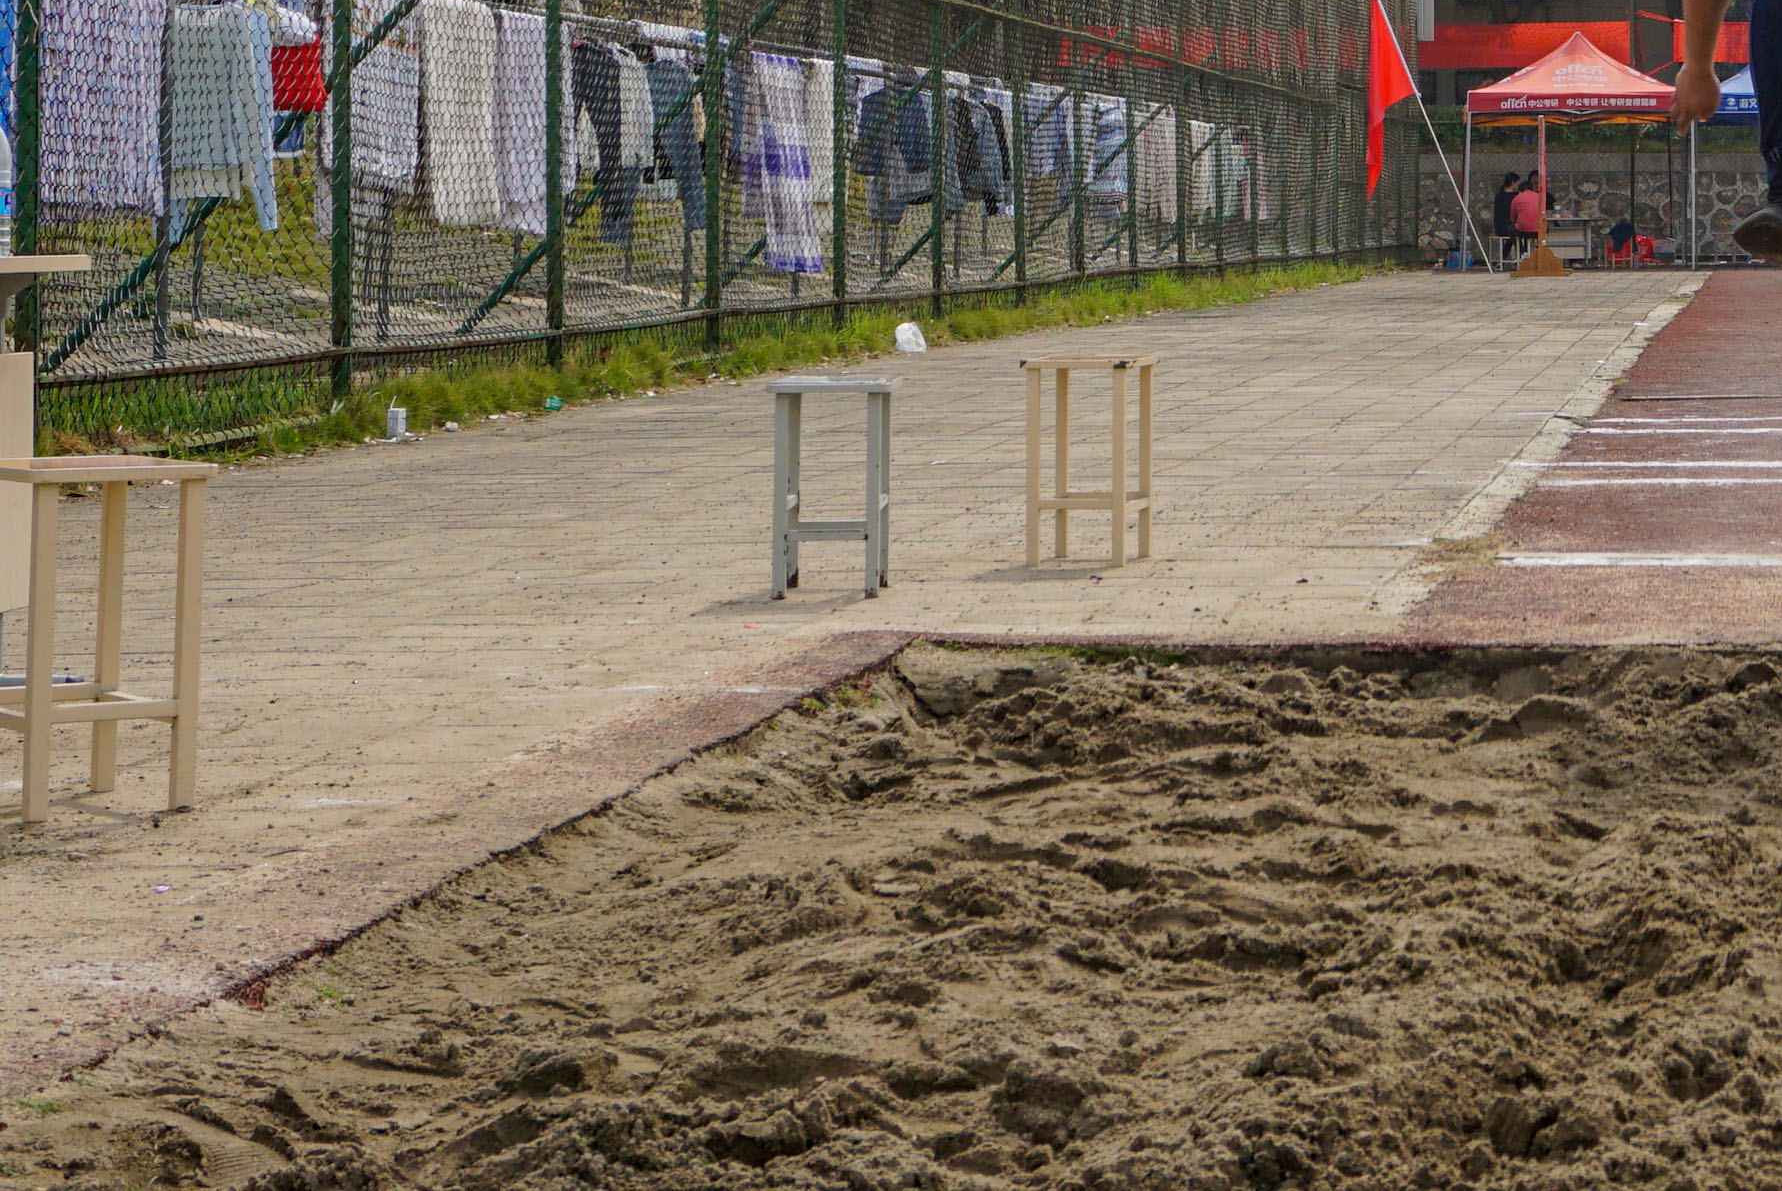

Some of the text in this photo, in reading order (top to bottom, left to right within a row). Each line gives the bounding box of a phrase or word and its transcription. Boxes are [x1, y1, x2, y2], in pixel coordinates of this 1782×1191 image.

[1500, 95, 1528, 109] offcn
[1528, 98, 1559, 108] 中公考研
[1566, 98, 1599, 107] 中公考研
